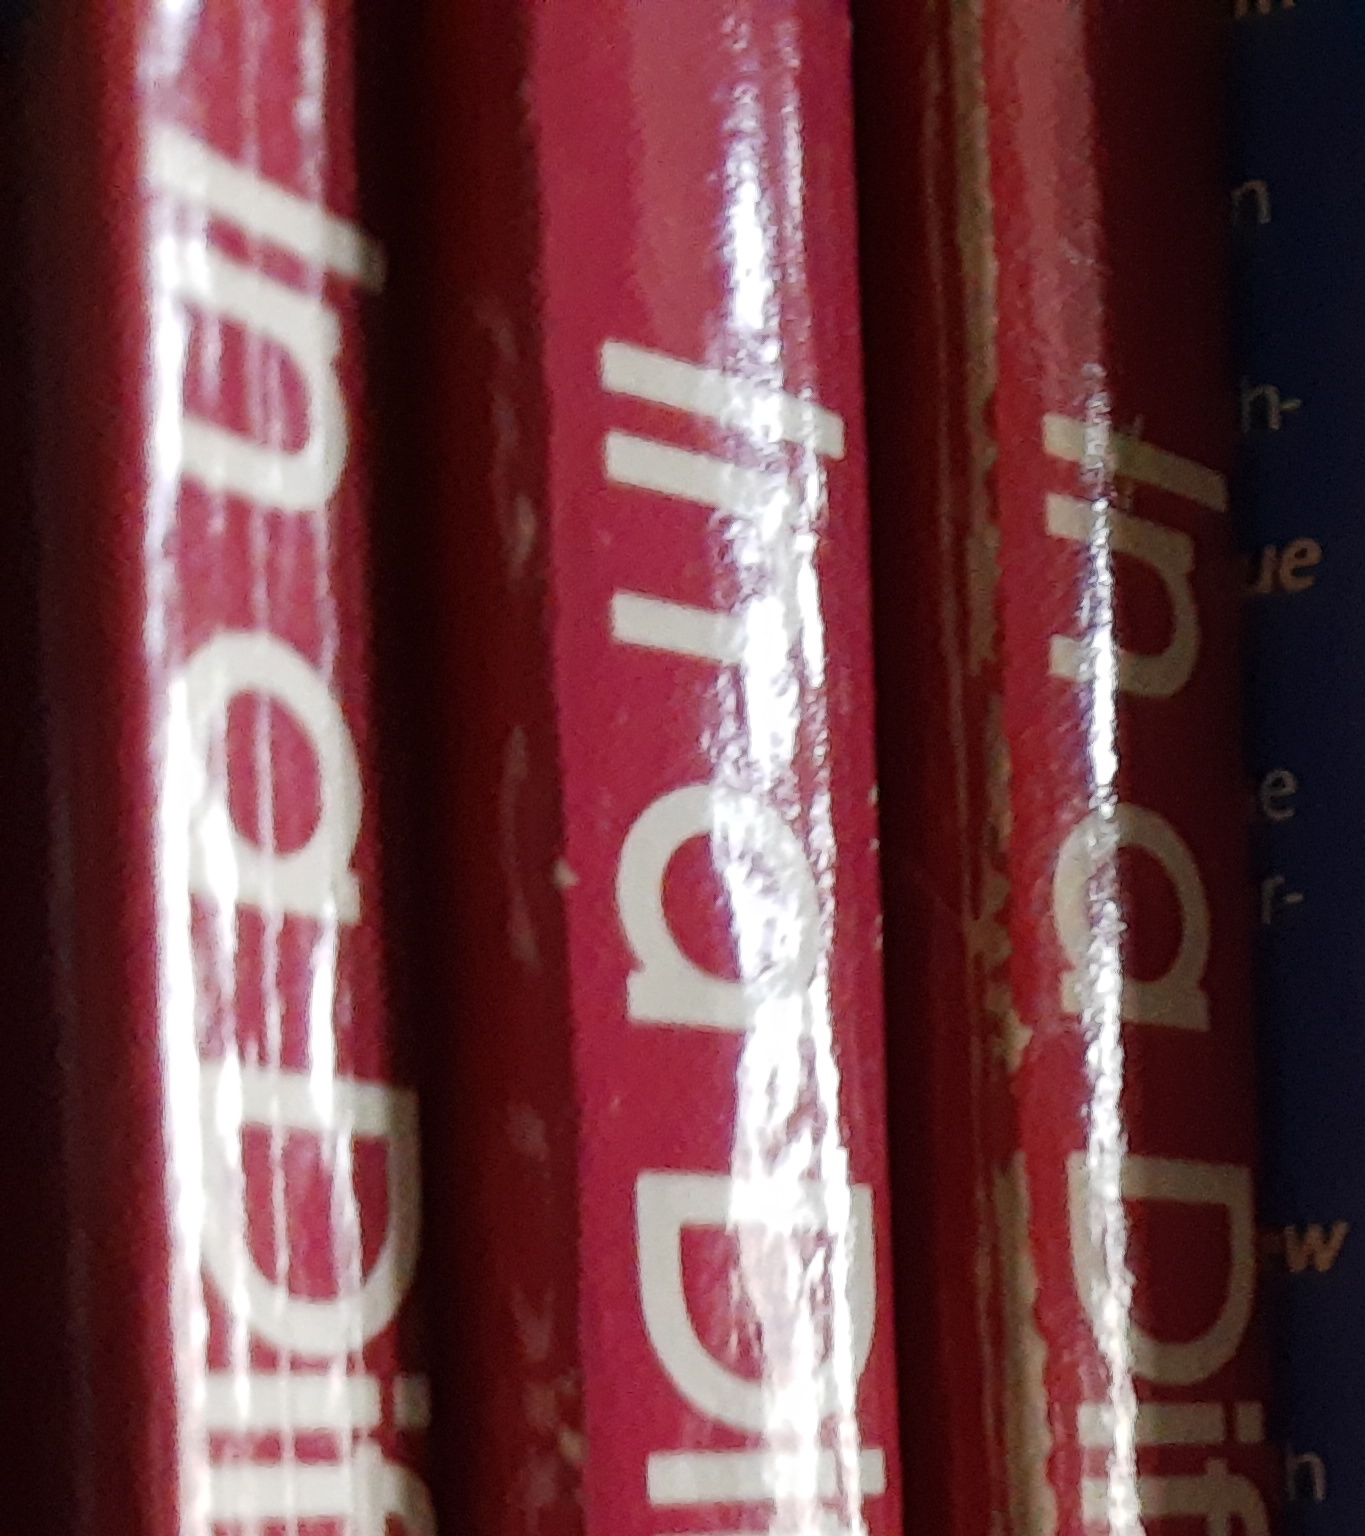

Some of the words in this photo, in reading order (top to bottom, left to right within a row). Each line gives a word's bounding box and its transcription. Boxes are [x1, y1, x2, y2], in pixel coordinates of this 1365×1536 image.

[143, 121, 385, 514] In
[601, 340, 845, 666] In
[1043, 408, 1230, 702] In
[168, 630, 363, 927] a
[615, 780, 836, 1031] a
[1050, 803, 1213, 1034] a
